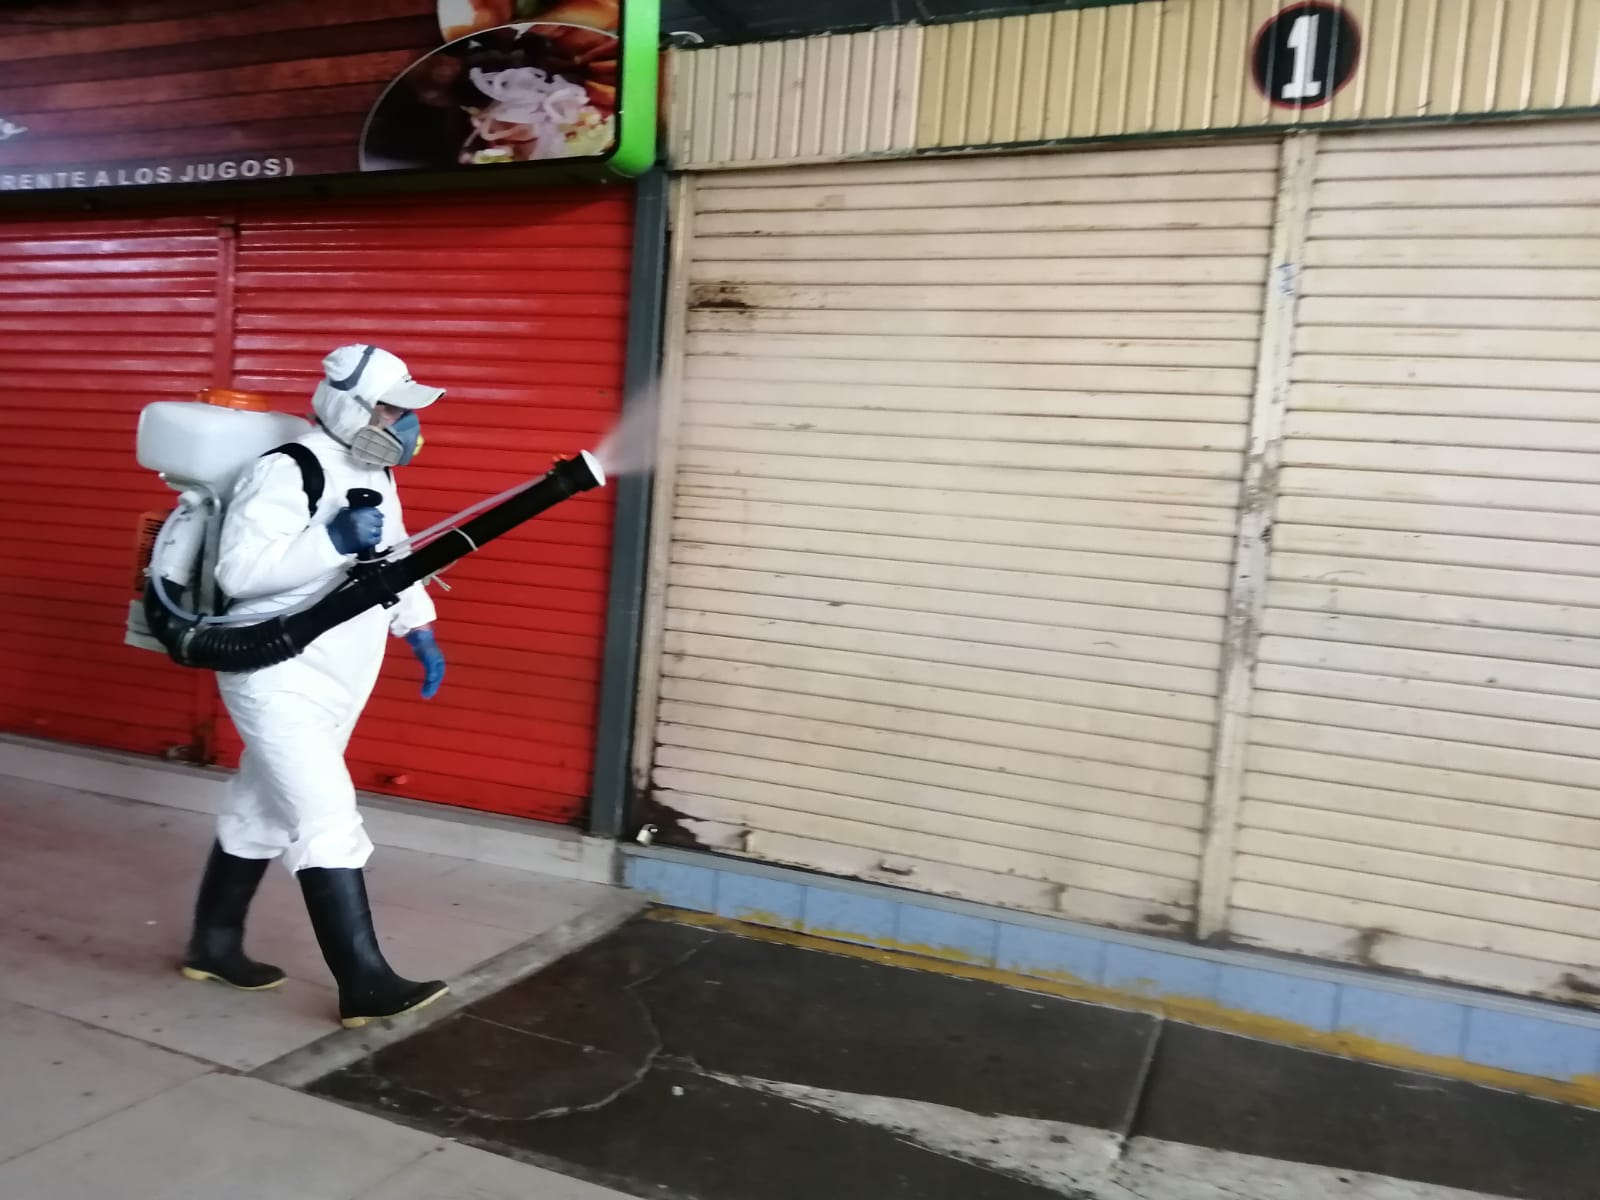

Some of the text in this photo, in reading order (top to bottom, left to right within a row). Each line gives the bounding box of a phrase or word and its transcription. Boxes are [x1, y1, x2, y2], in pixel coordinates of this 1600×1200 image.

[1281, 14, 1322, 99] 1
[93, 170, 111, 187] A
[117, 166, 172, 186] LOS
[179, 157, 294, 182] JUGOS)
